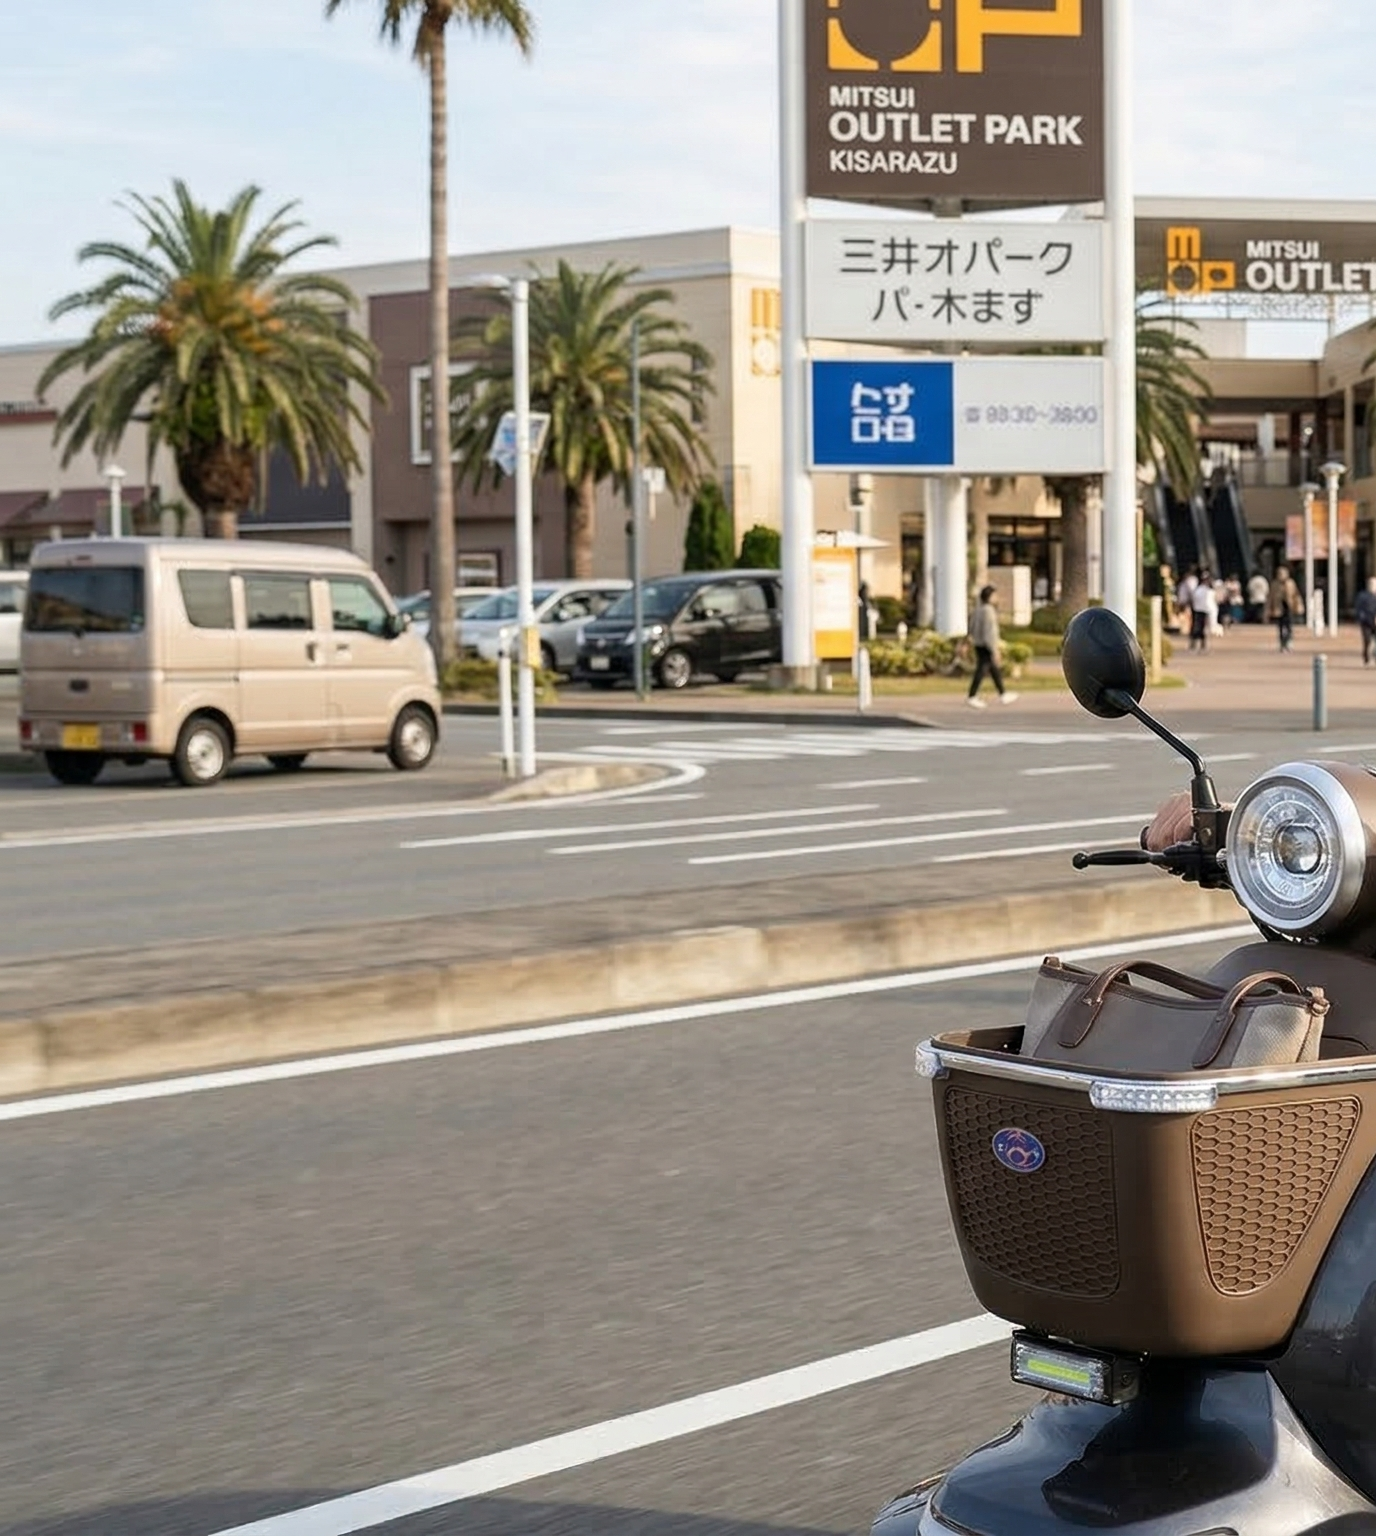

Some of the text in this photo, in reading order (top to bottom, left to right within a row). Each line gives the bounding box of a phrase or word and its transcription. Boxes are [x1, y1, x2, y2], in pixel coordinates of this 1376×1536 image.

[828, 86, 915, 108] MITSUI
[828, 111, 1083, 146] OUTLET PARK
[829, 149, 958, 174] KISARAZU
[840, 236, 1073, 276] 三井オパーク
[1246, 240, 1320, 260] MITSUI
